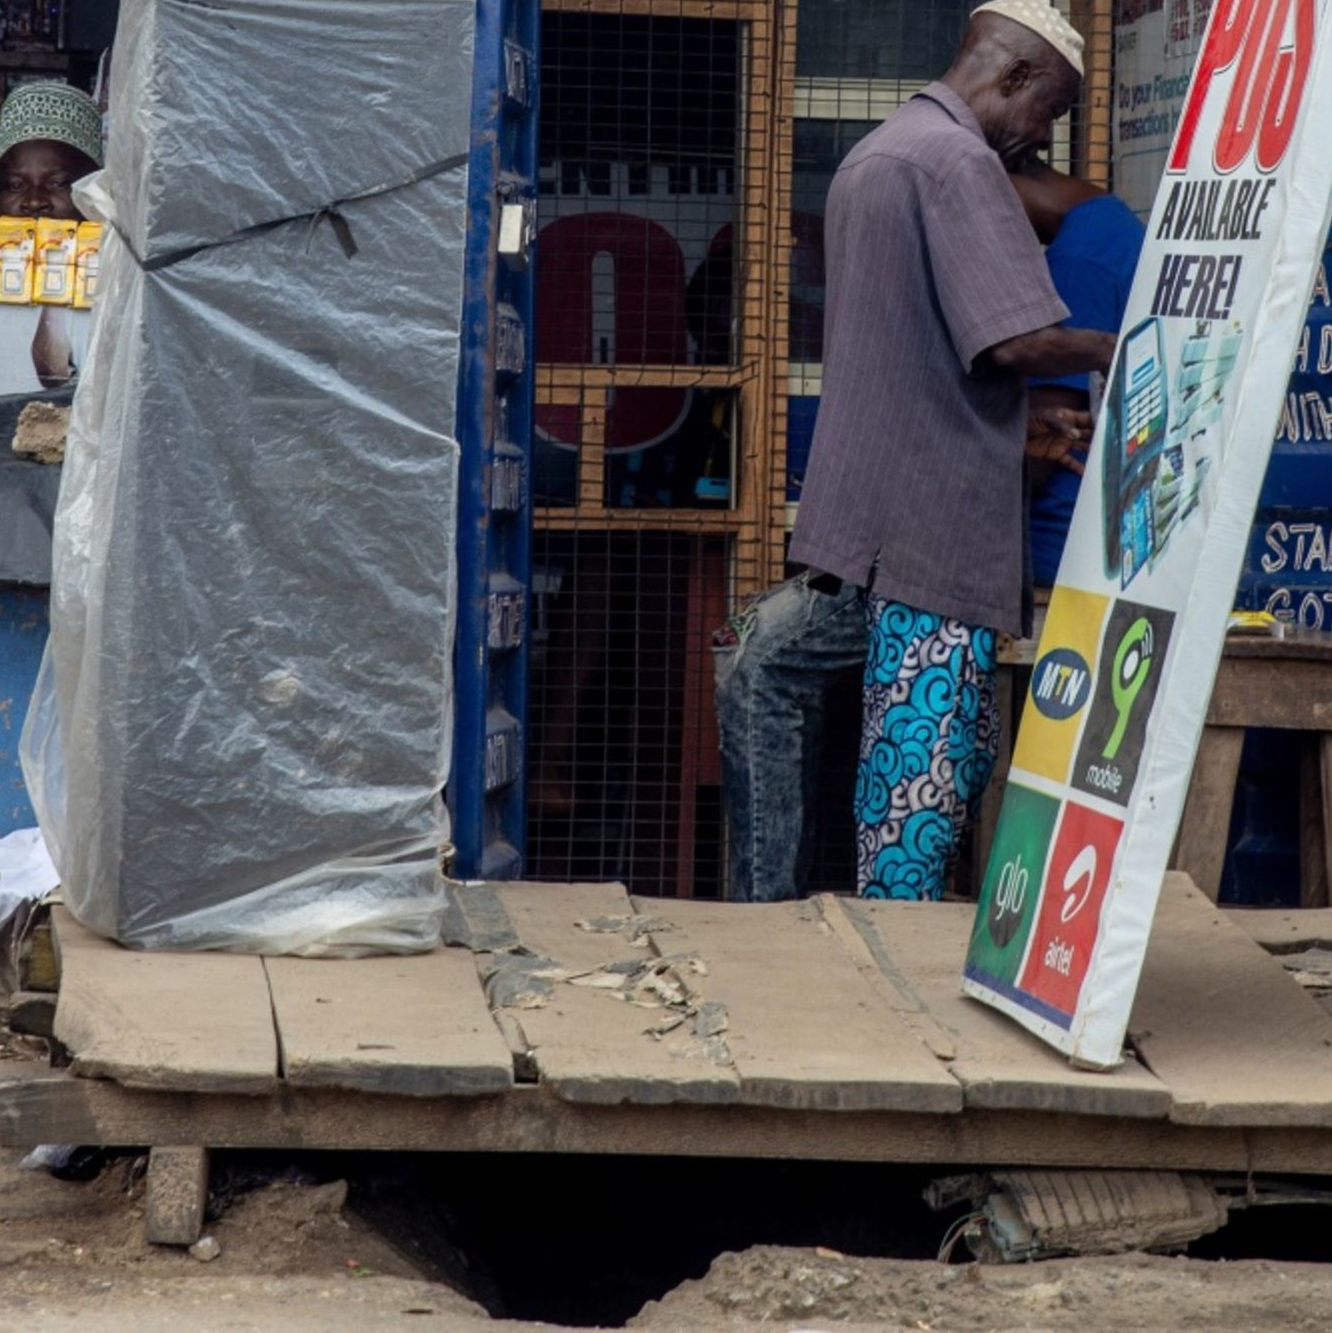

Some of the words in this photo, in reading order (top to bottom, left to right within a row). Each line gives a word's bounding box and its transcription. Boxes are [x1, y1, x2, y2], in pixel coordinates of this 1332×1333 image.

[1155, 177, 1278, 242] AVAILABLE
[1149, 254, 1244, 321] HERE!
[1037, 662, 1085, 703] MTN
[1085, 765, 1124, 795] mobile
[995, 858, 1028, 924] glo
[1044, 938, 1073, 978] airtel
